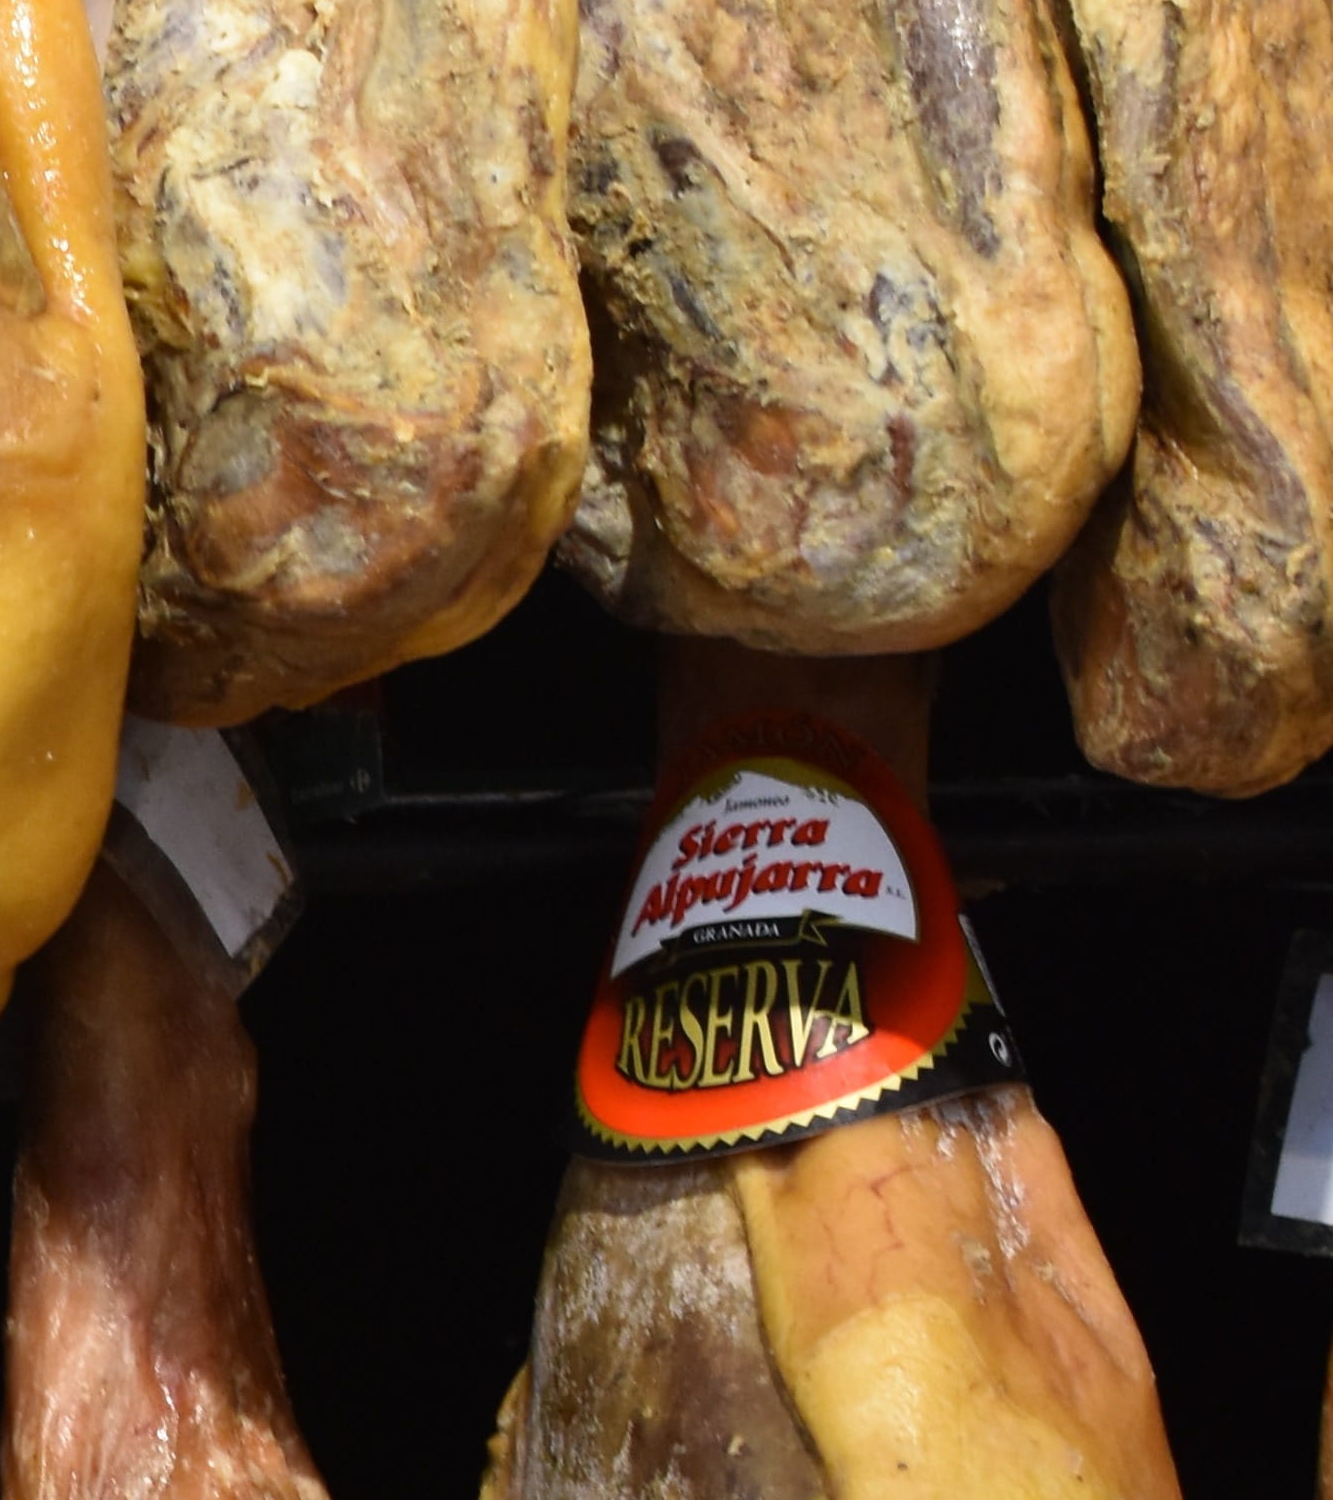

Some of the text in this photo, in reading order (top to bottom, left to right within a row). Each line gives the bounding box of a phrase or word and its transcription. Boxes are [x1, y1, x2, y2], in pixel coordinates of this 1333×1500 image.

[672, 815, 830, 870] Sierra
[632, 854, 885, 938] Alpujarra
[692, 921, 782, 944] GRANADA
[615, 960, 870, 1090] RESERVA
